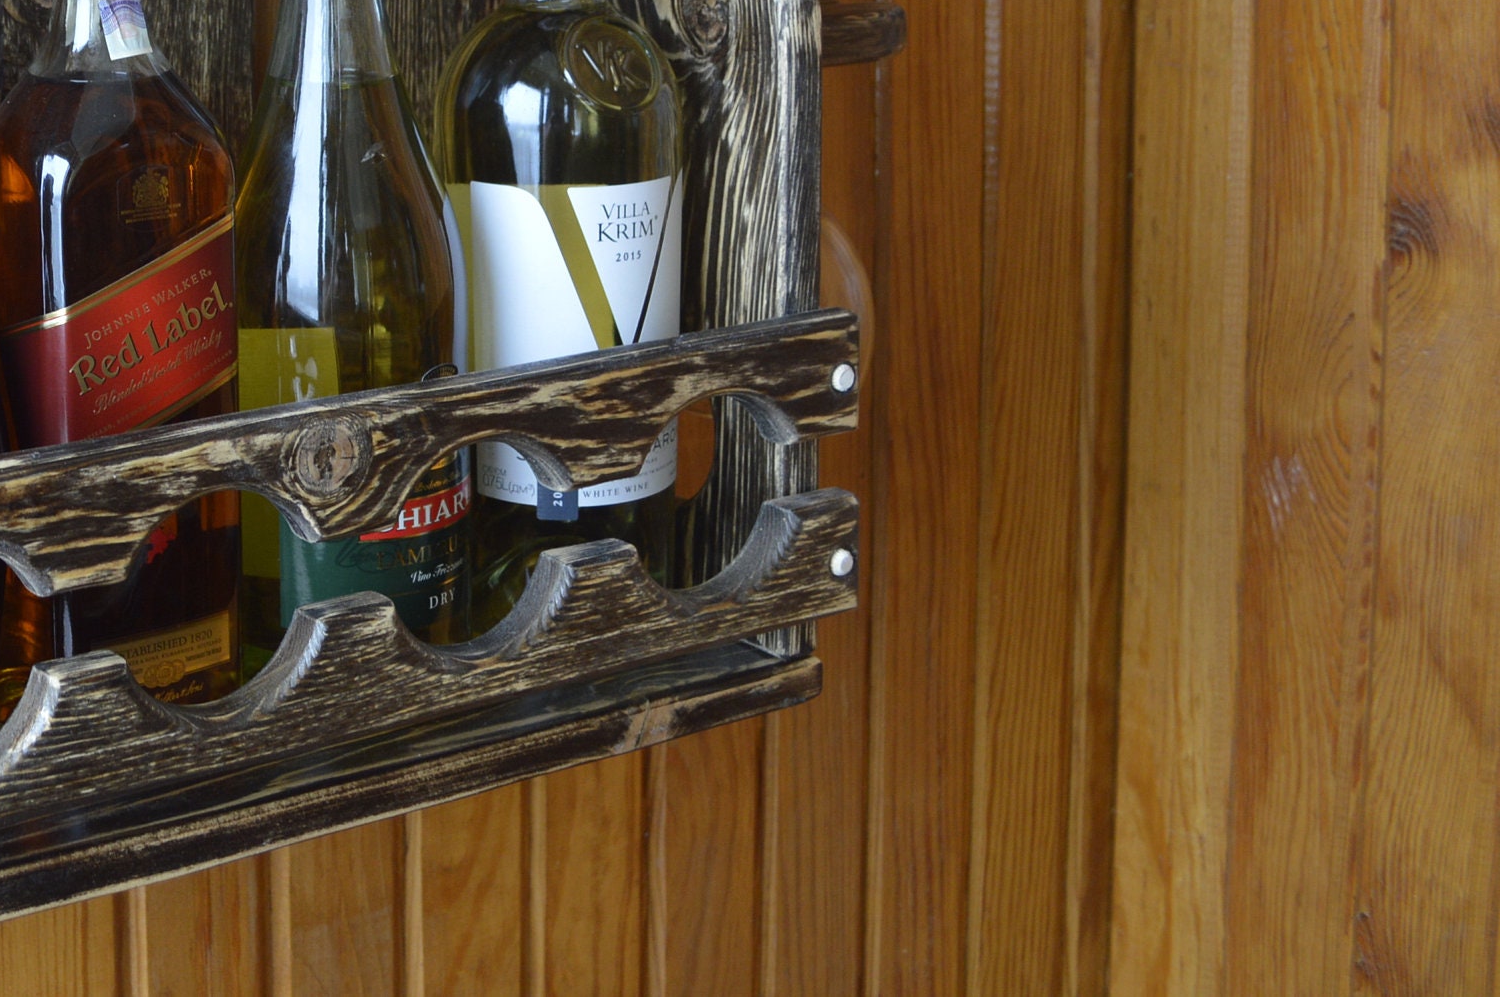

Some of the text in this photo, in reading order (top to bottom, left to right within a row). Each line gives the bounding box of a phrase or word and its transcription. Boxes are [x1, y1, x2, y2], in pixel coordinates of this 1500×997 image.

[601, 201, 651, 220] VILLA
[597, 219, 655, 243] KRIM
[615, 250, 642, 262] 2015
[84, 267, 209, 349] JOHNNIE WALKER
[69, 326, 144, 397] Red
[142, 280, 229, 352] Label
[92, 371, 146, 415] Blended
[183, 328, 223, 363] Whisky
[582, 481, 650, 500] WHITE WINE
[429, 587, 456, 610] DRY
